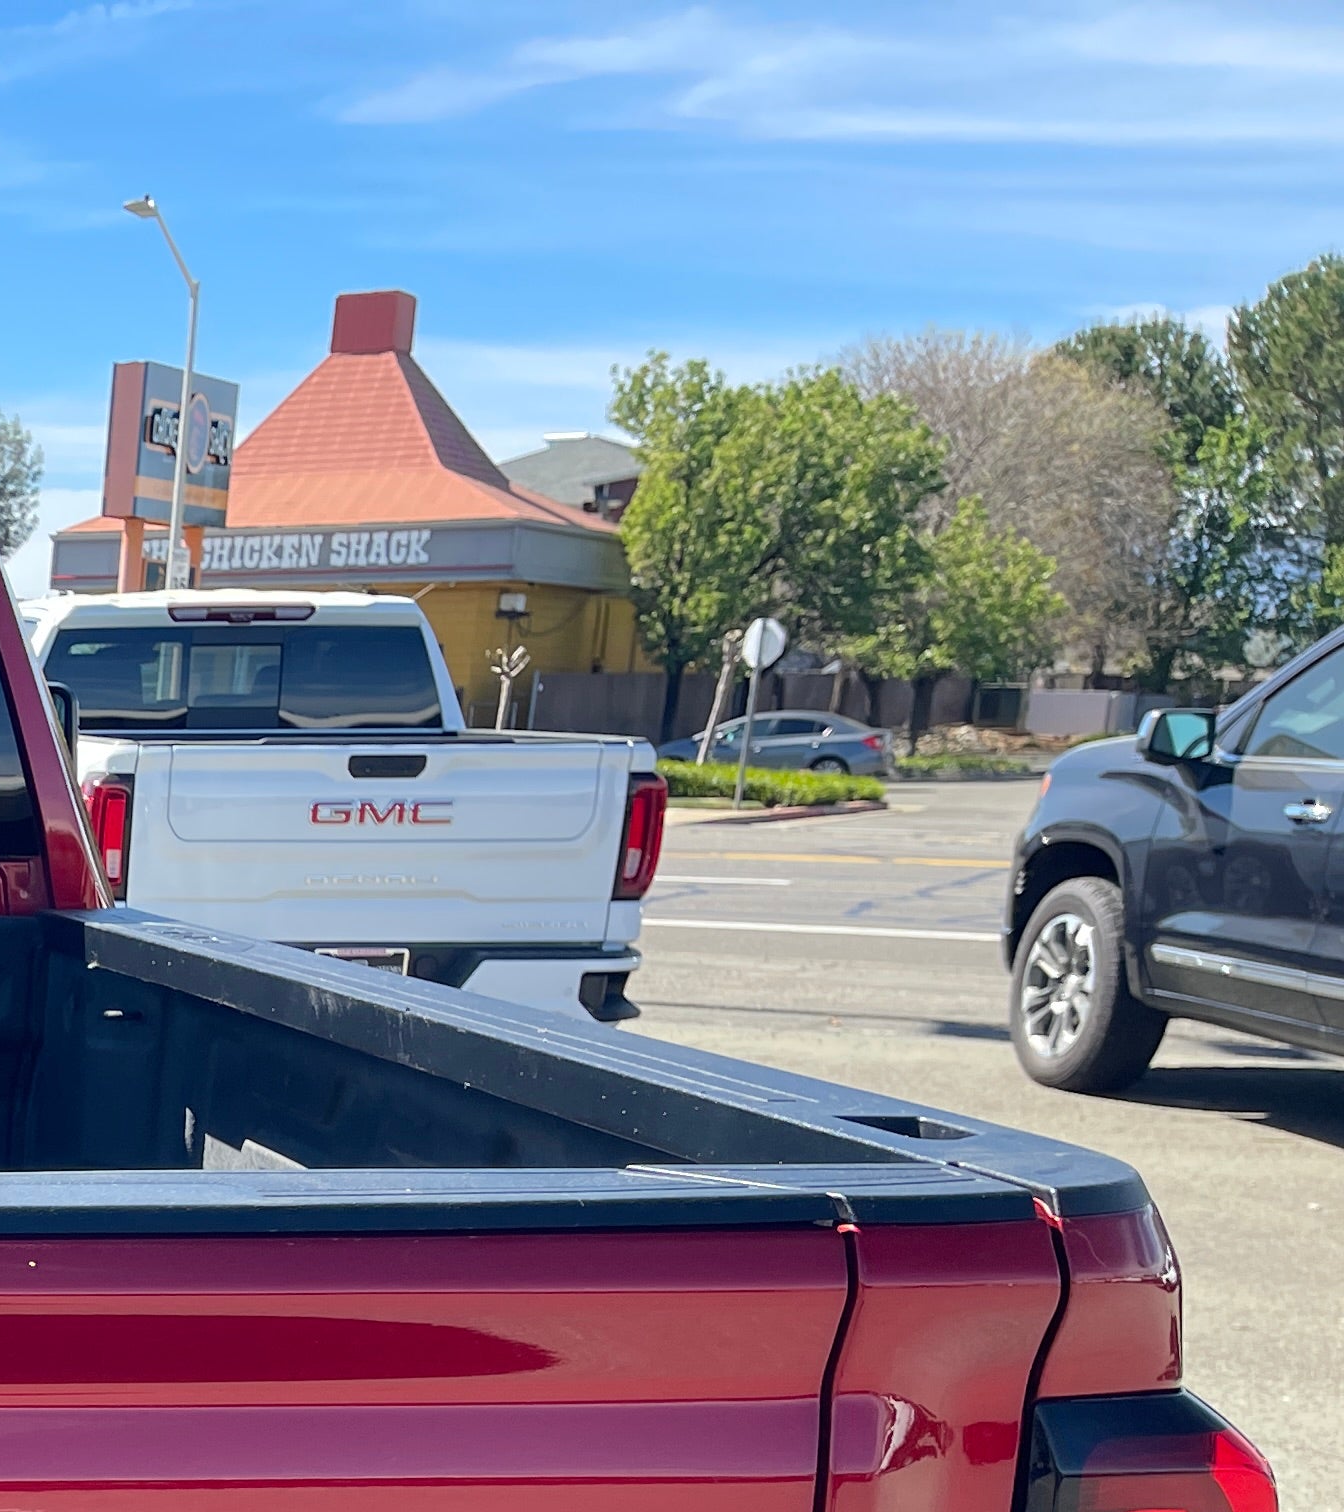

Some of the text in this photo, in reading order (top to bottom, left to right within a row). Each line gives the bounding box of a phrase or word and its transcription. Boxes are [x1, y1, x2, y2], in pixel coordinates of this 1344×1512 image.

[201, 533, 324, 570] CHICKEN
[330, 528, 433, 567] SHACK
[309, 798, 454, 826] GMC
